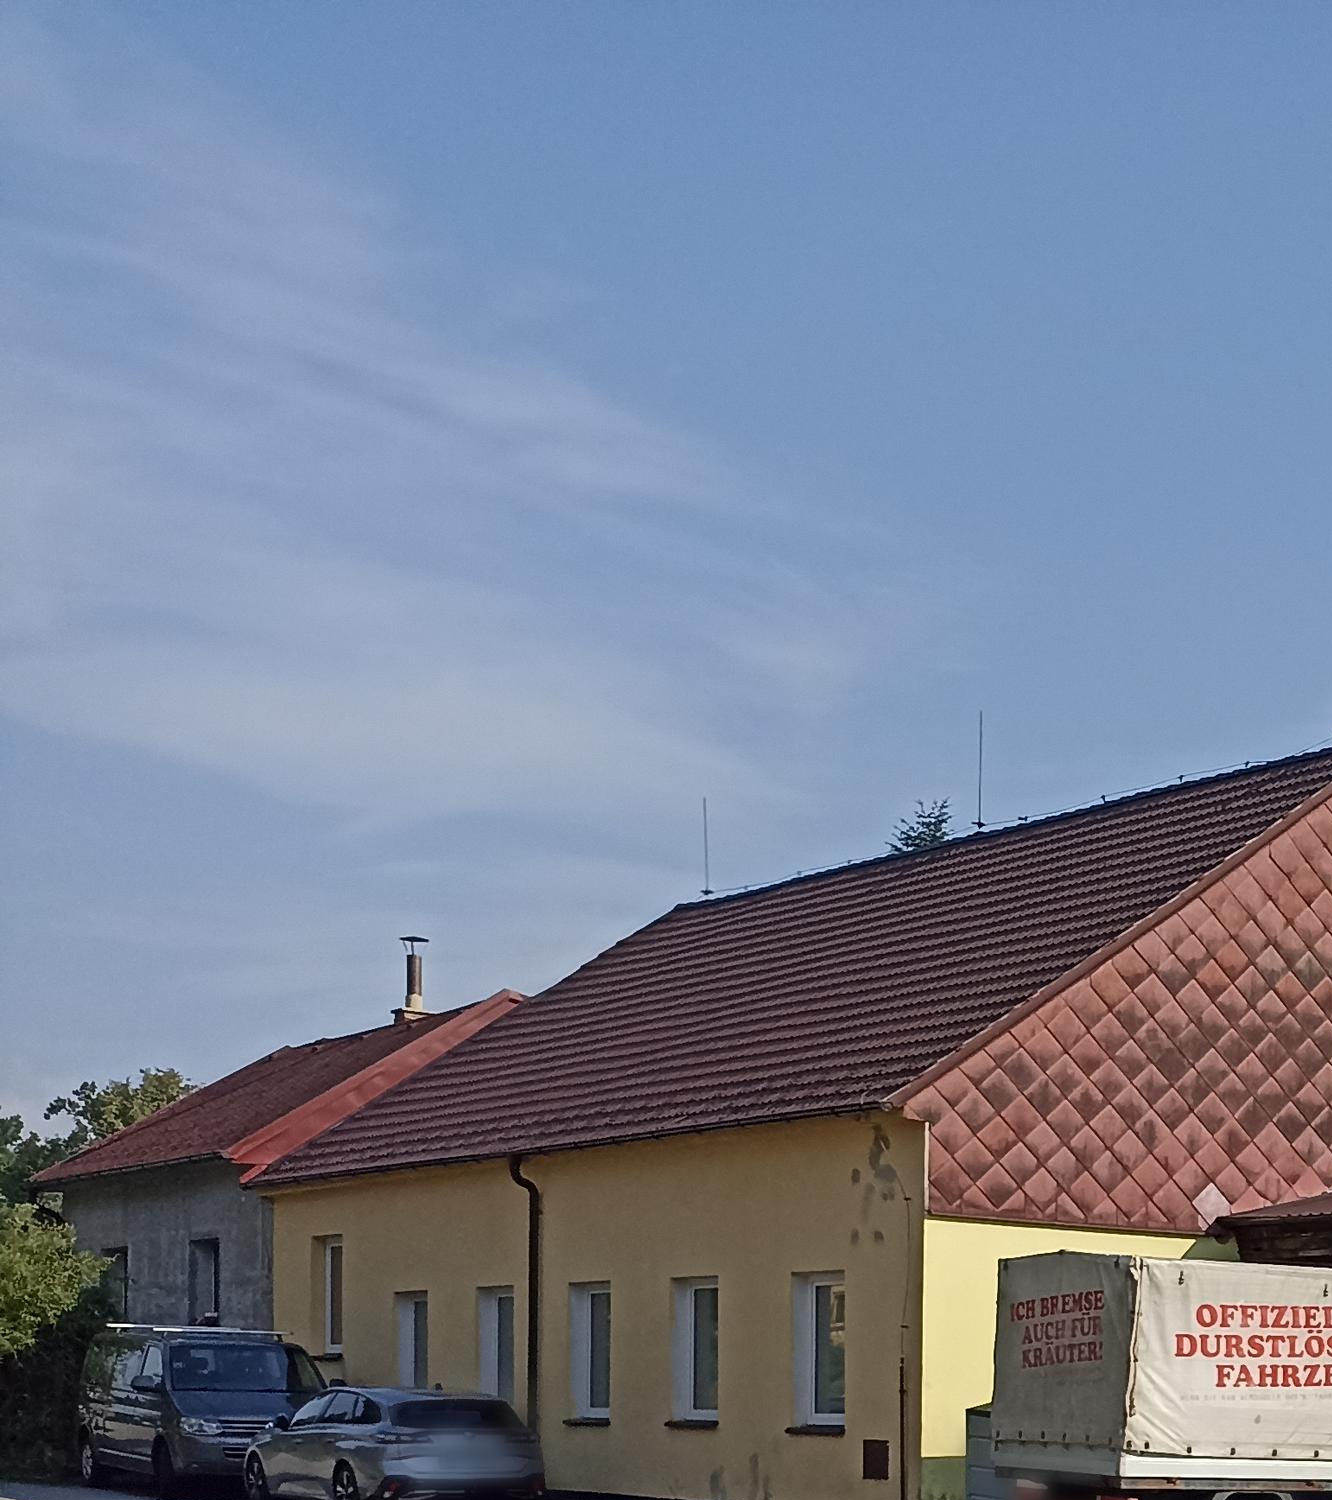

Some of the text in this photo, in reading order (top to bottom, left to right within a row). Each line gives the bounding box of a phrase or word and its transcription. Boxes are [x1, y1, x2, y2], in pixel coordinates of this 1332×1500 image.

[1010, 1290, 1105, 1322] ICH BREMSE
[1022, 1312, 1103, 1344] AUCH FÜR
[1022, 1341, 1104, 1368] KRÄUTER!
